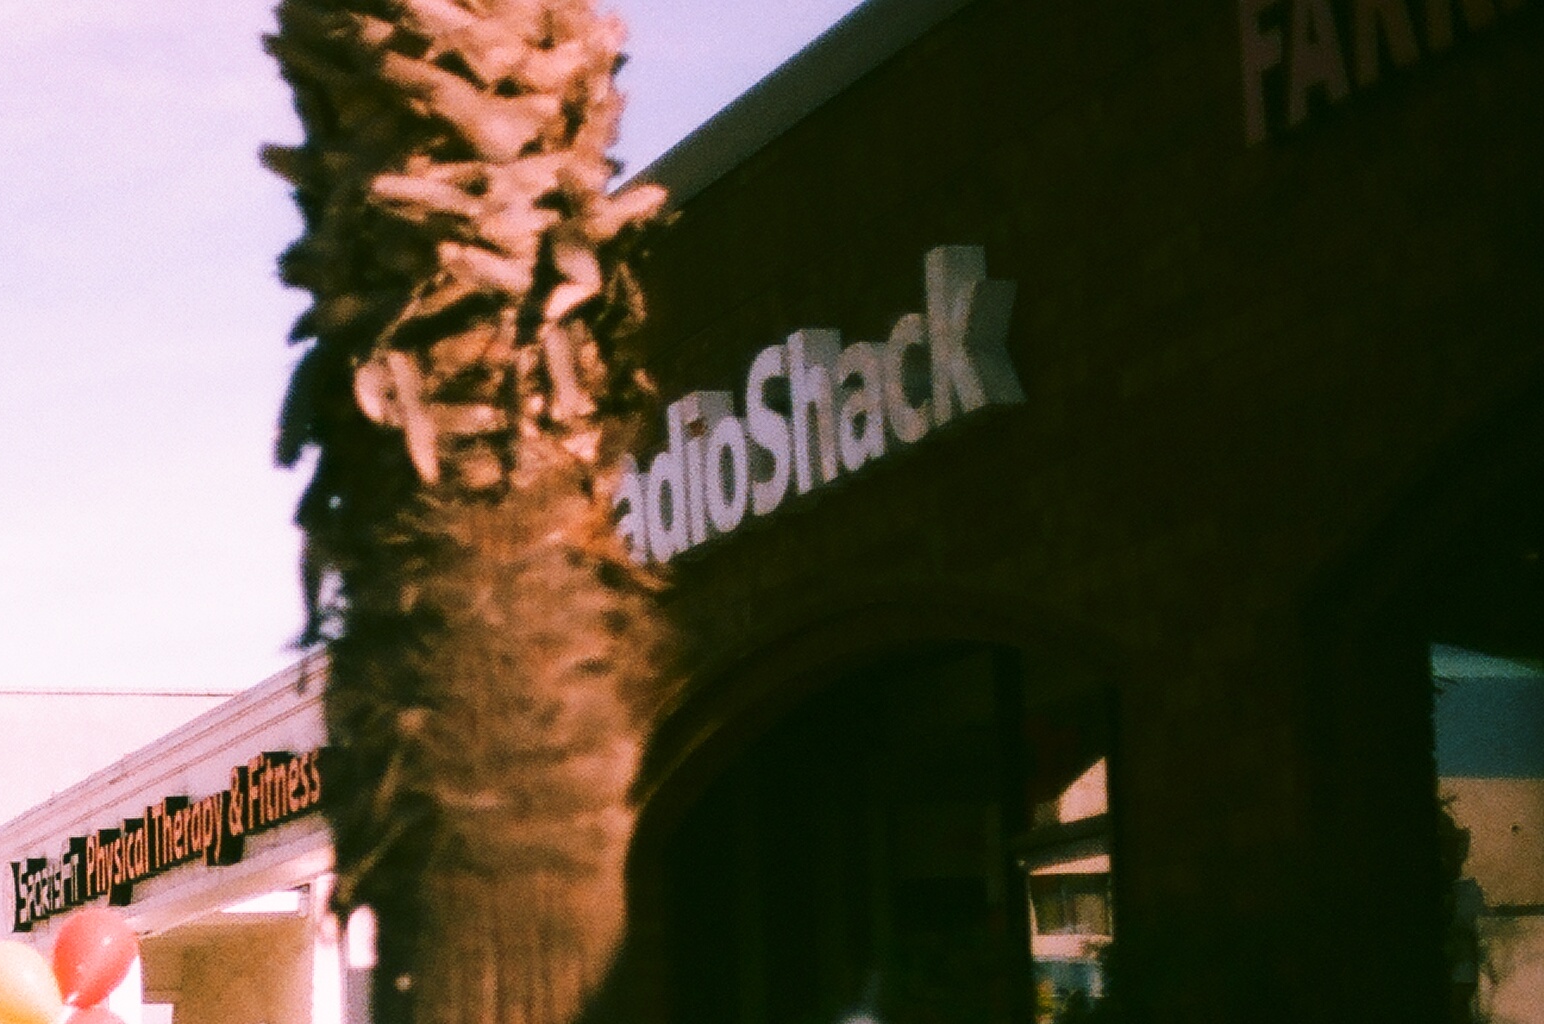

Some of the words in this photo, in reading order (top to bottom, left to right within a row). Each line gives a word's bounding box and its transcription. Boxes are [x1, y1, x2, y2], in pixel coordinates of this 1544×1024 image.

[612, 246, 1024, 564] adioShack
[85, 806, 149, 902] Physical
[152, 790, 223, 866] Therapy
[228, 766, 244, 836] &
[247, 749, 320, 830] Fitness
